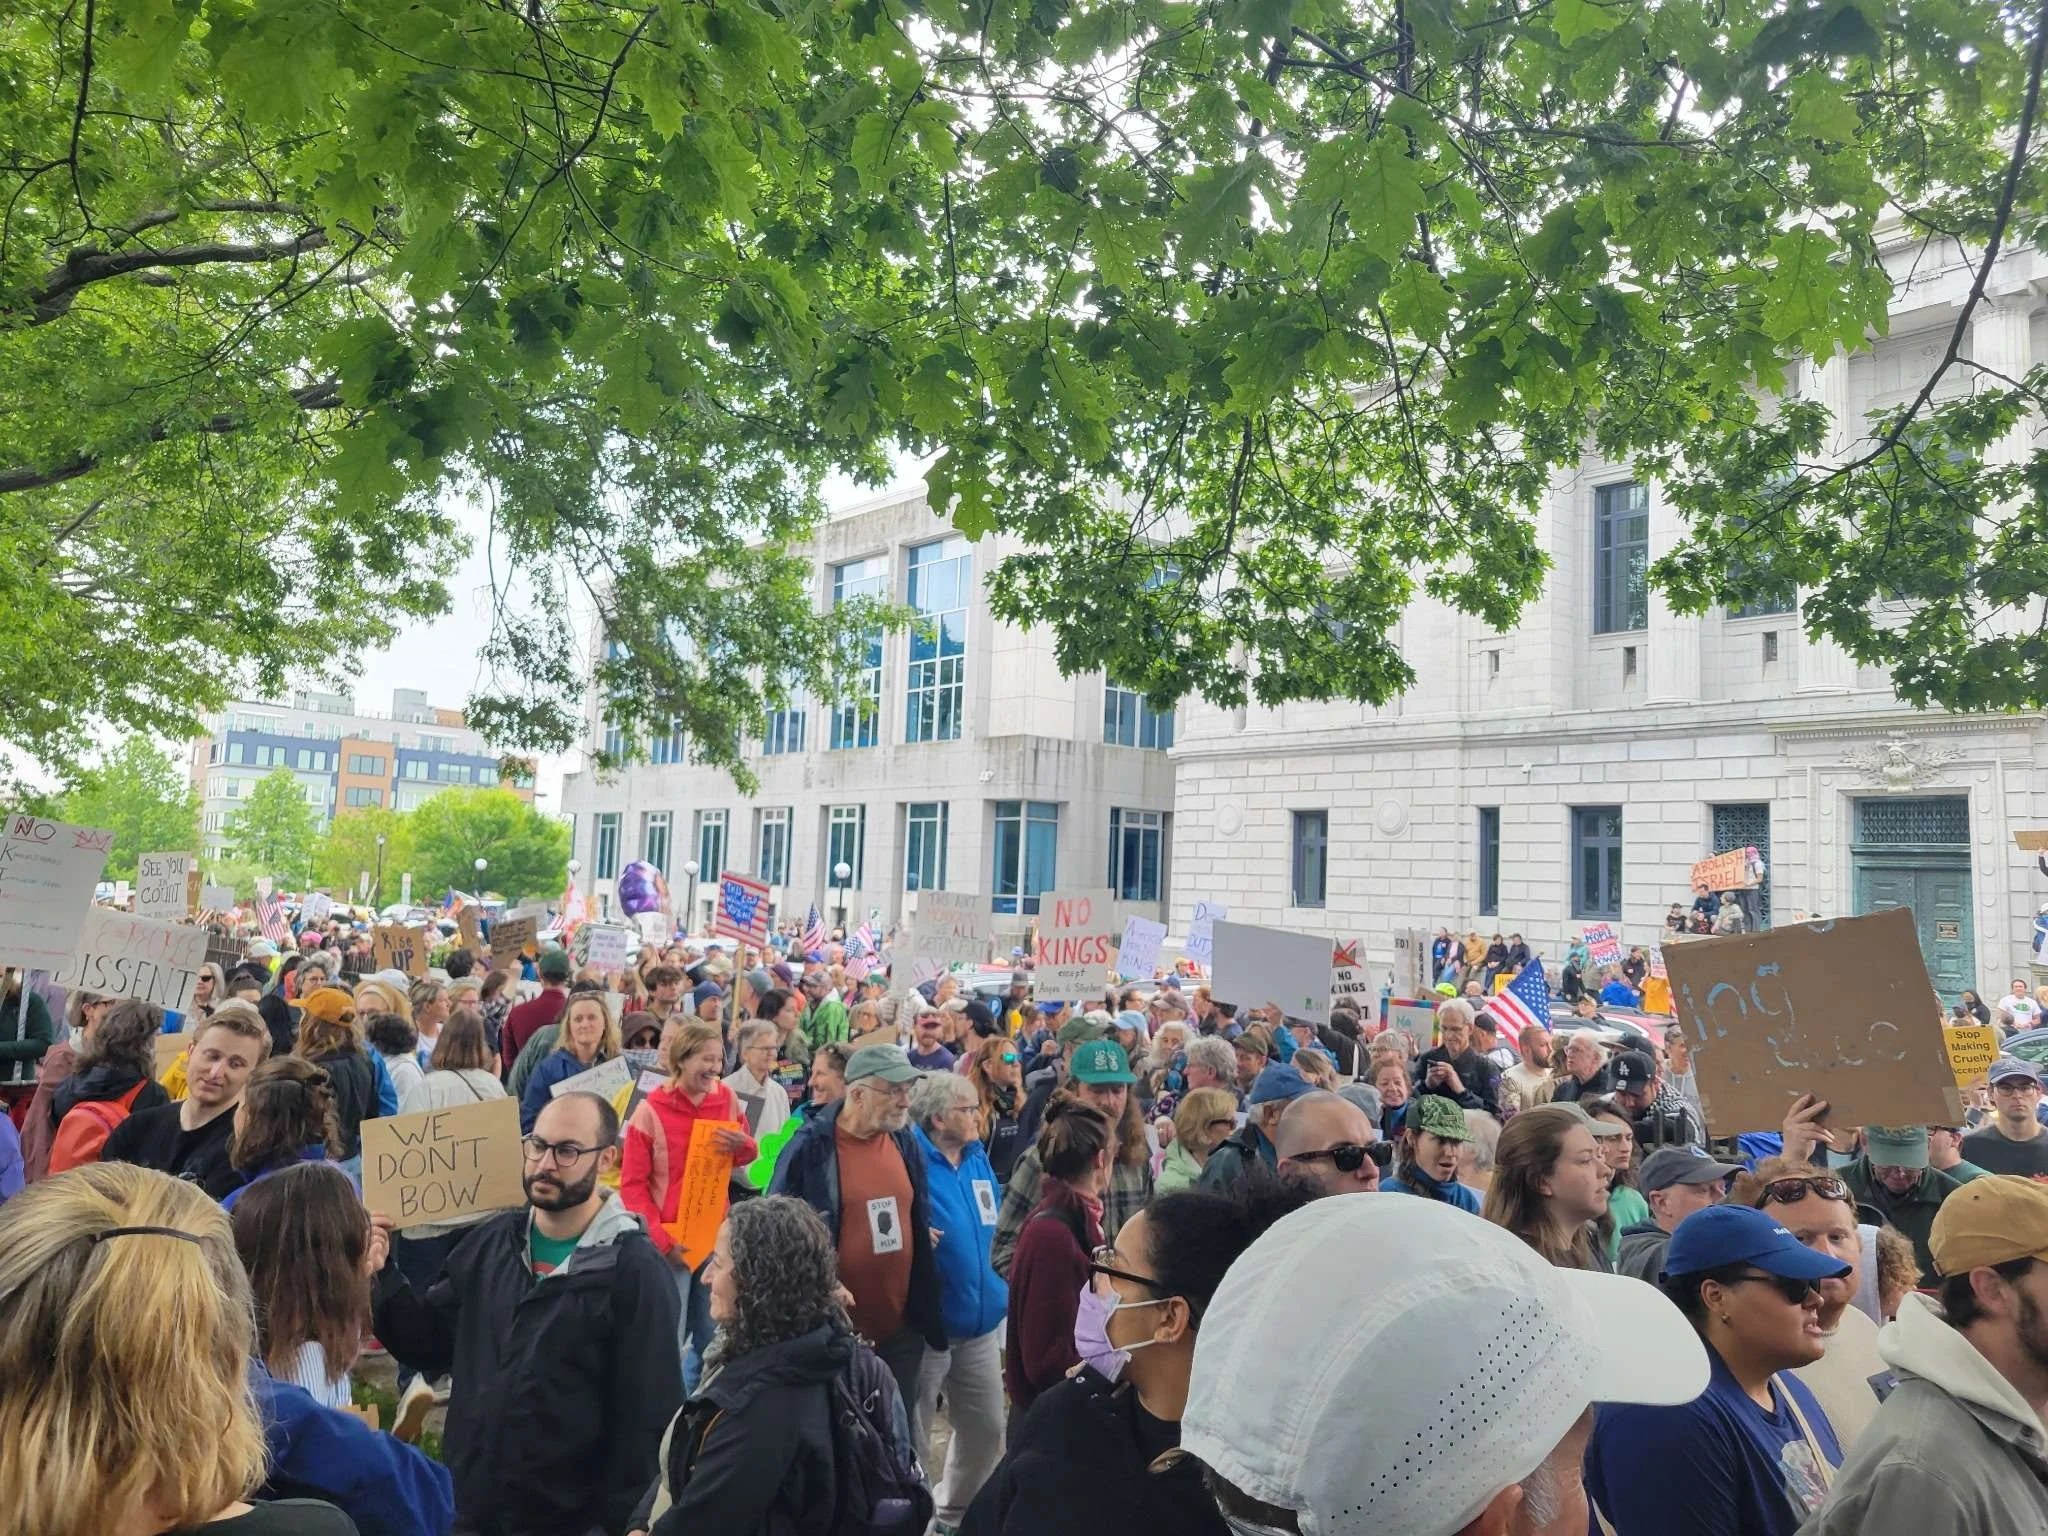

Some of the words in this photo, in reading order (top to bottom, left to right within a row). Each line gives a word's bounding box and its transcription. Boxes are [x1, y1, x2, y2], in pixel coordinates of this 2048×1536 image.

[14, 816, 56, 840] NO
[141, 858, 162, 877] SEE
[167, 857, 184, 879] YOU
[1693, 851, 1743, 876] ABOLISH
[1692, 868, 1744, 890] ISRAEL
[1055, 897, 1091, 928] NO
[1038, 934, 1109, 965] KINGS
[53, 950, 198, 1009] DISSENT
[1338, 971, 1352, 981] NO
[1952, 1042, 1990, 1051] Making
[1955, 1031, 1981, 1039] Stop
[1953, 1053, 1993, 1063] Cruelty
[389, 1112, 455, 1146] WE
[379, 1137, 489, 1184] DON'T
[401, 1174, 482, 1217] BOW
[871, 1200, 892, 1210] STOP
